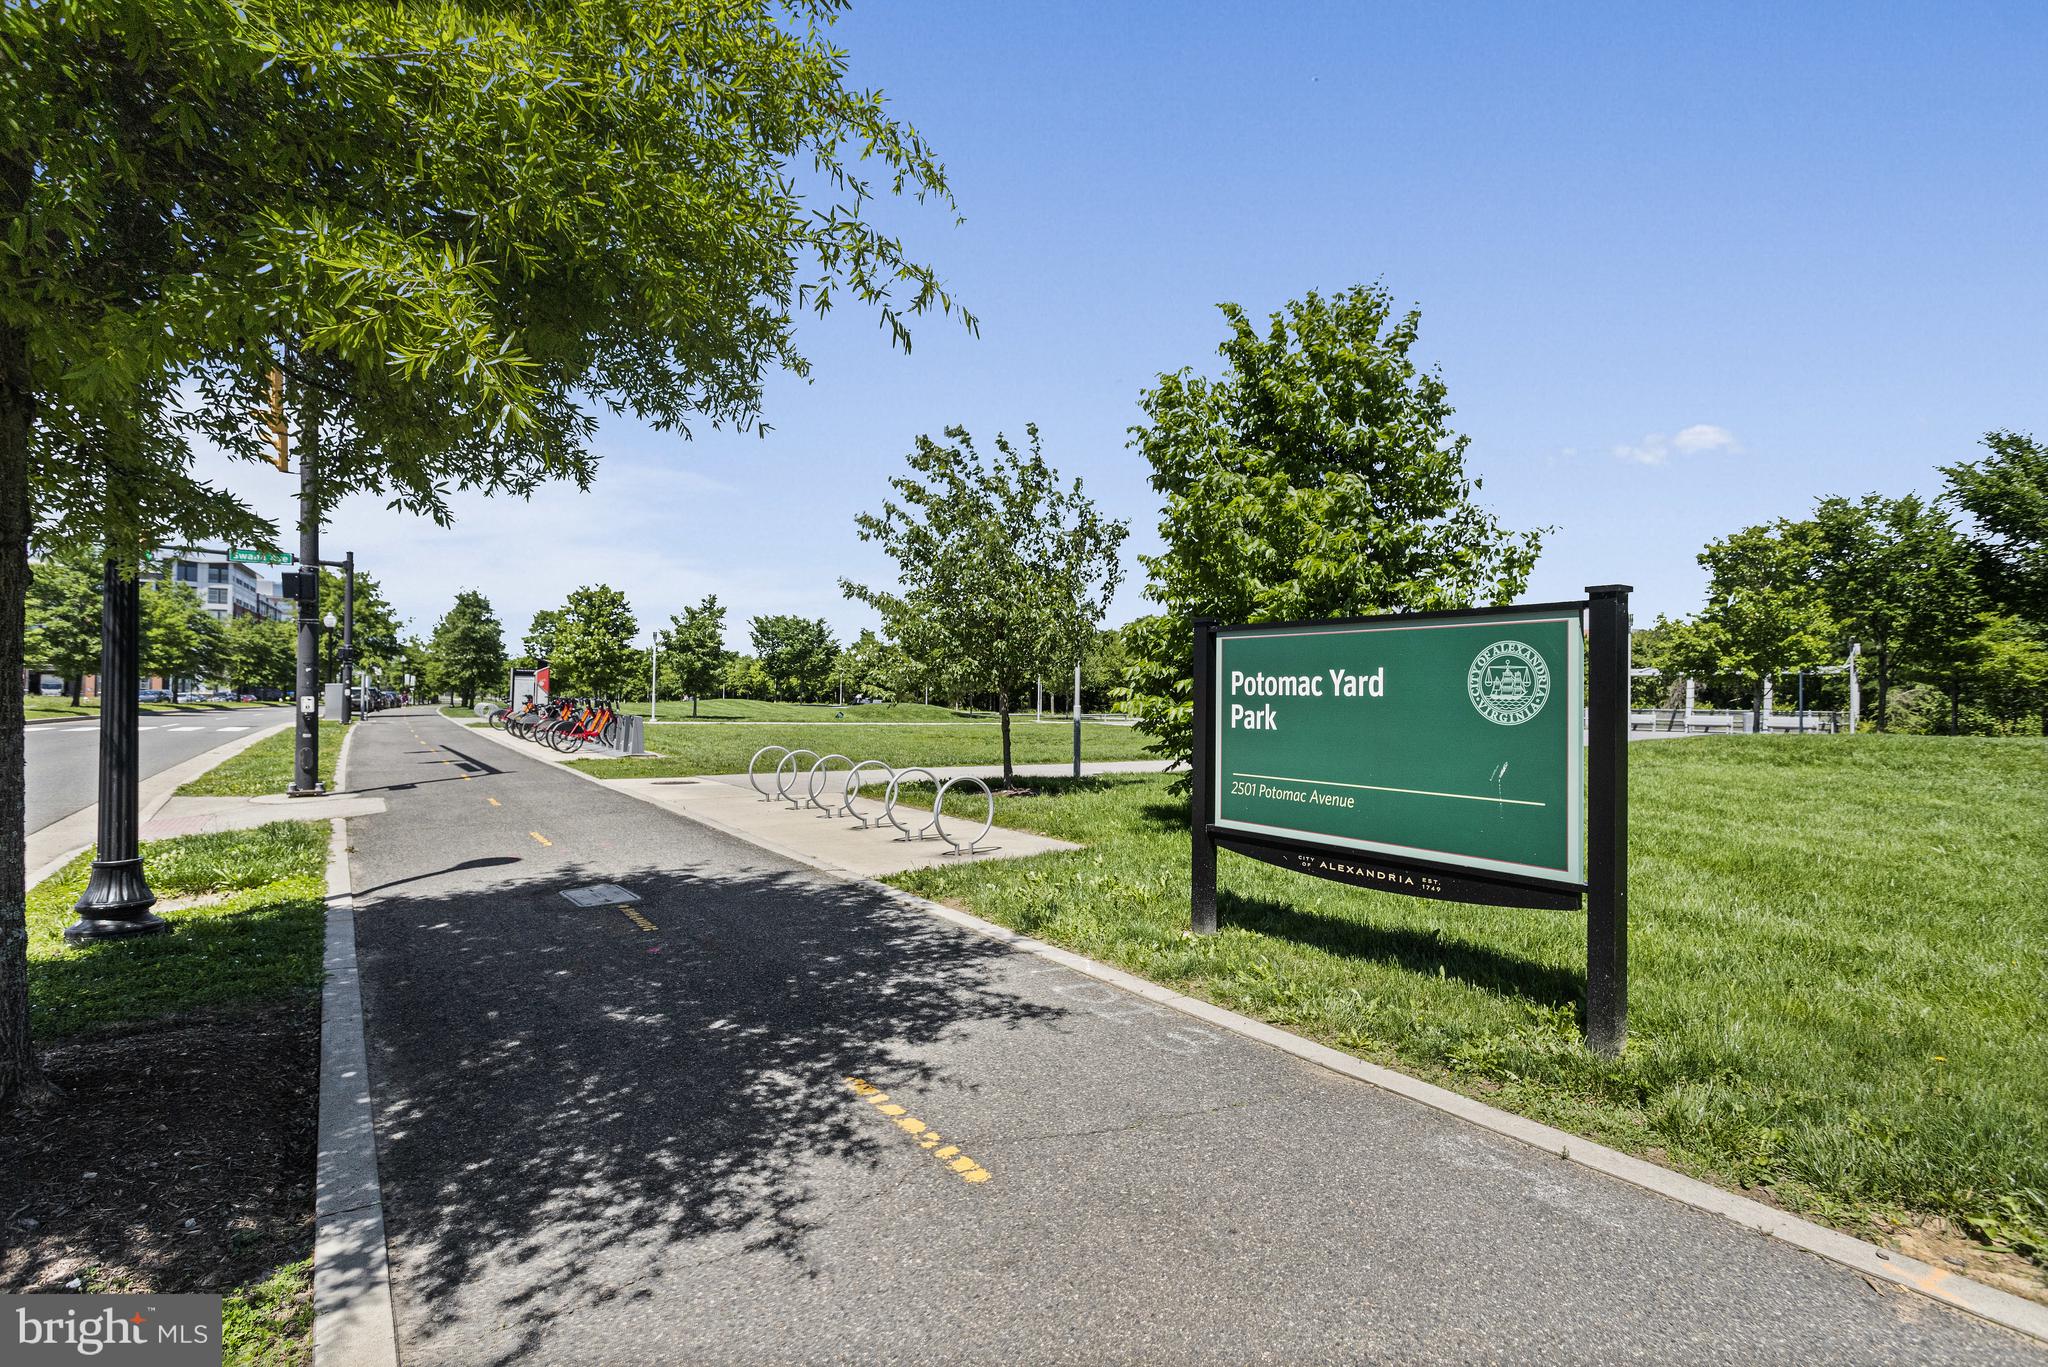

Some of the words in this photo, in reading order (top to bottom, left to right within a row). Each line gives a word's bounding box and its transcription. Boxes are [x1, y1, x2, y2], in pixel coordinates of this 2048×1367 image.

[1231, 671, 1323, 696] Potomac
[1329, 667, 1384, 697] Yard
[1471, 667, 1482, 697] CITY
[1477, 650, 1492, 667] OF
[1493, 643, 1548, 697] ALEXANDRIA
[1231, 703, 1278, 730] Park
[1478, 699, 1541, 723] VIRGINIA
[1231, 781, 1256, 796] 2501
[1258, 784, 1307, 803] Potomac
[1309, 789, 1355, 808] Avenue
[1319, 861, 1414, 885] ALEXANDRIA
[1422, 884, 1441, 892] 1749
